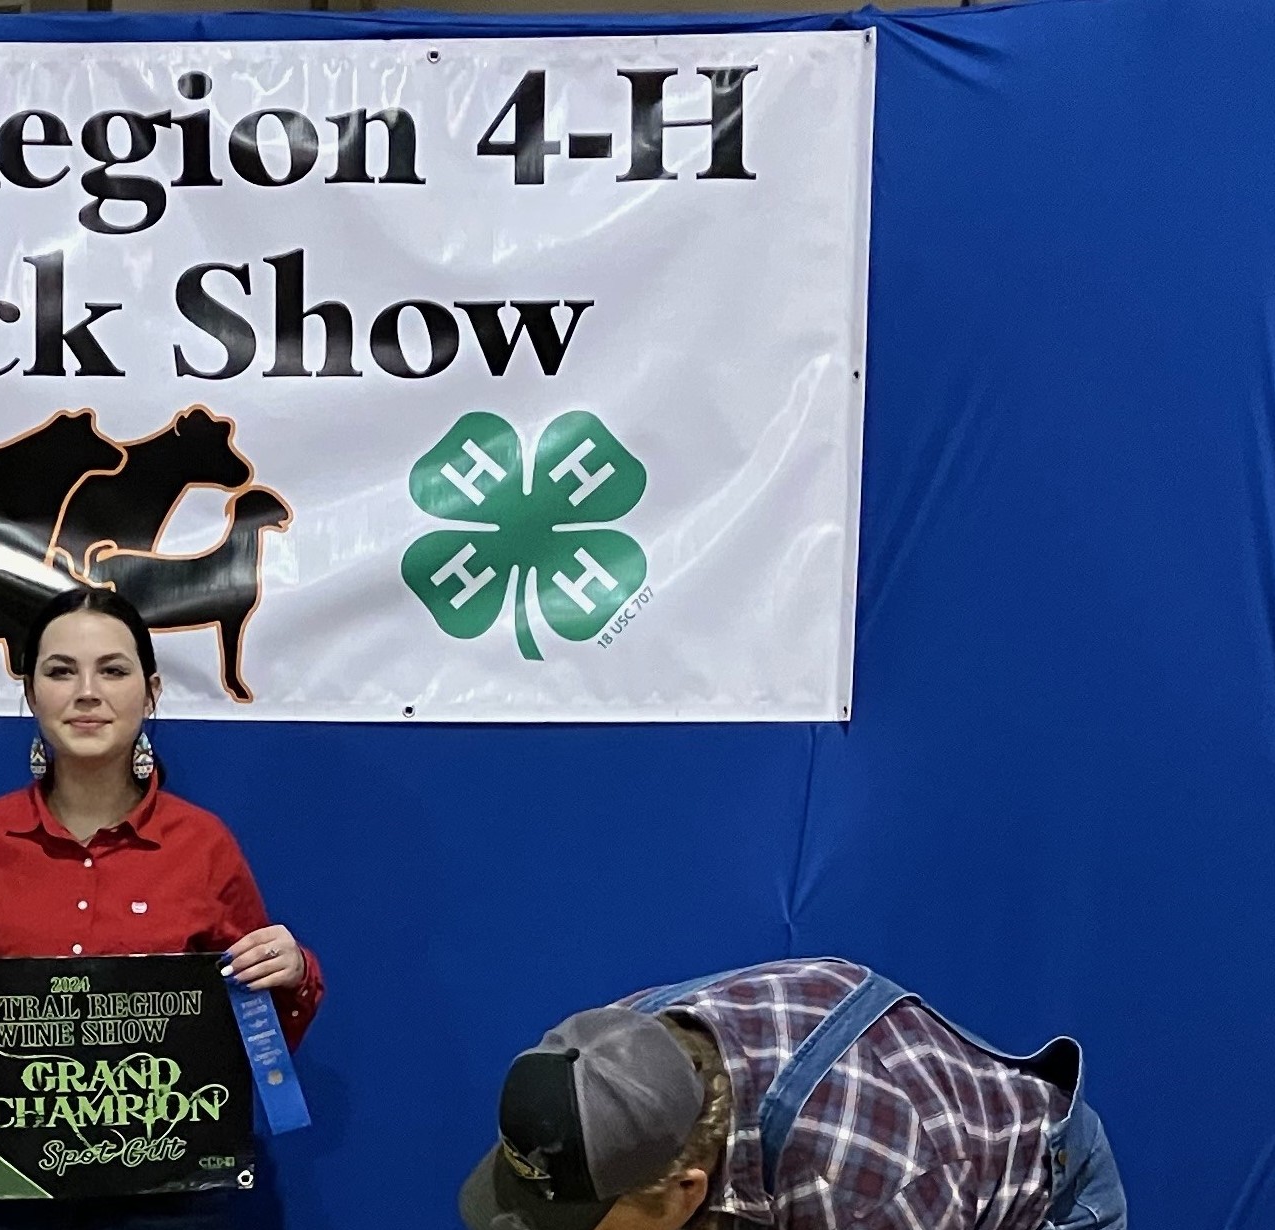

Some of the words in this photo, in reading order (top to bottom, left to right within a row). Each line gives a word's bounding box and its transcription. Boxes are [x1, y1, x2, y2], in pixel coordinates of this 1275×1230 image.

[475, 64, 760, 186] 4-H
[172, 248, 596, 381] Show
[440, 438, 507, 506] H
[548, 437, 616, 507] H
[430, 542, 497, 610] H
[551, 547, 619, 615] H
[597, 632, 614, 649] 18
[609, 607, 637, 634] USC
[630, 585, 654, 611] 707
[50, 975, 91, 993] 2024
[86, 990, 203, 1019] REGION
[80, 1017, 170, 1047] SHOW
[20, 1056, 182, 1094] GRAND
[38, 1139, 119, 1177] Spot
